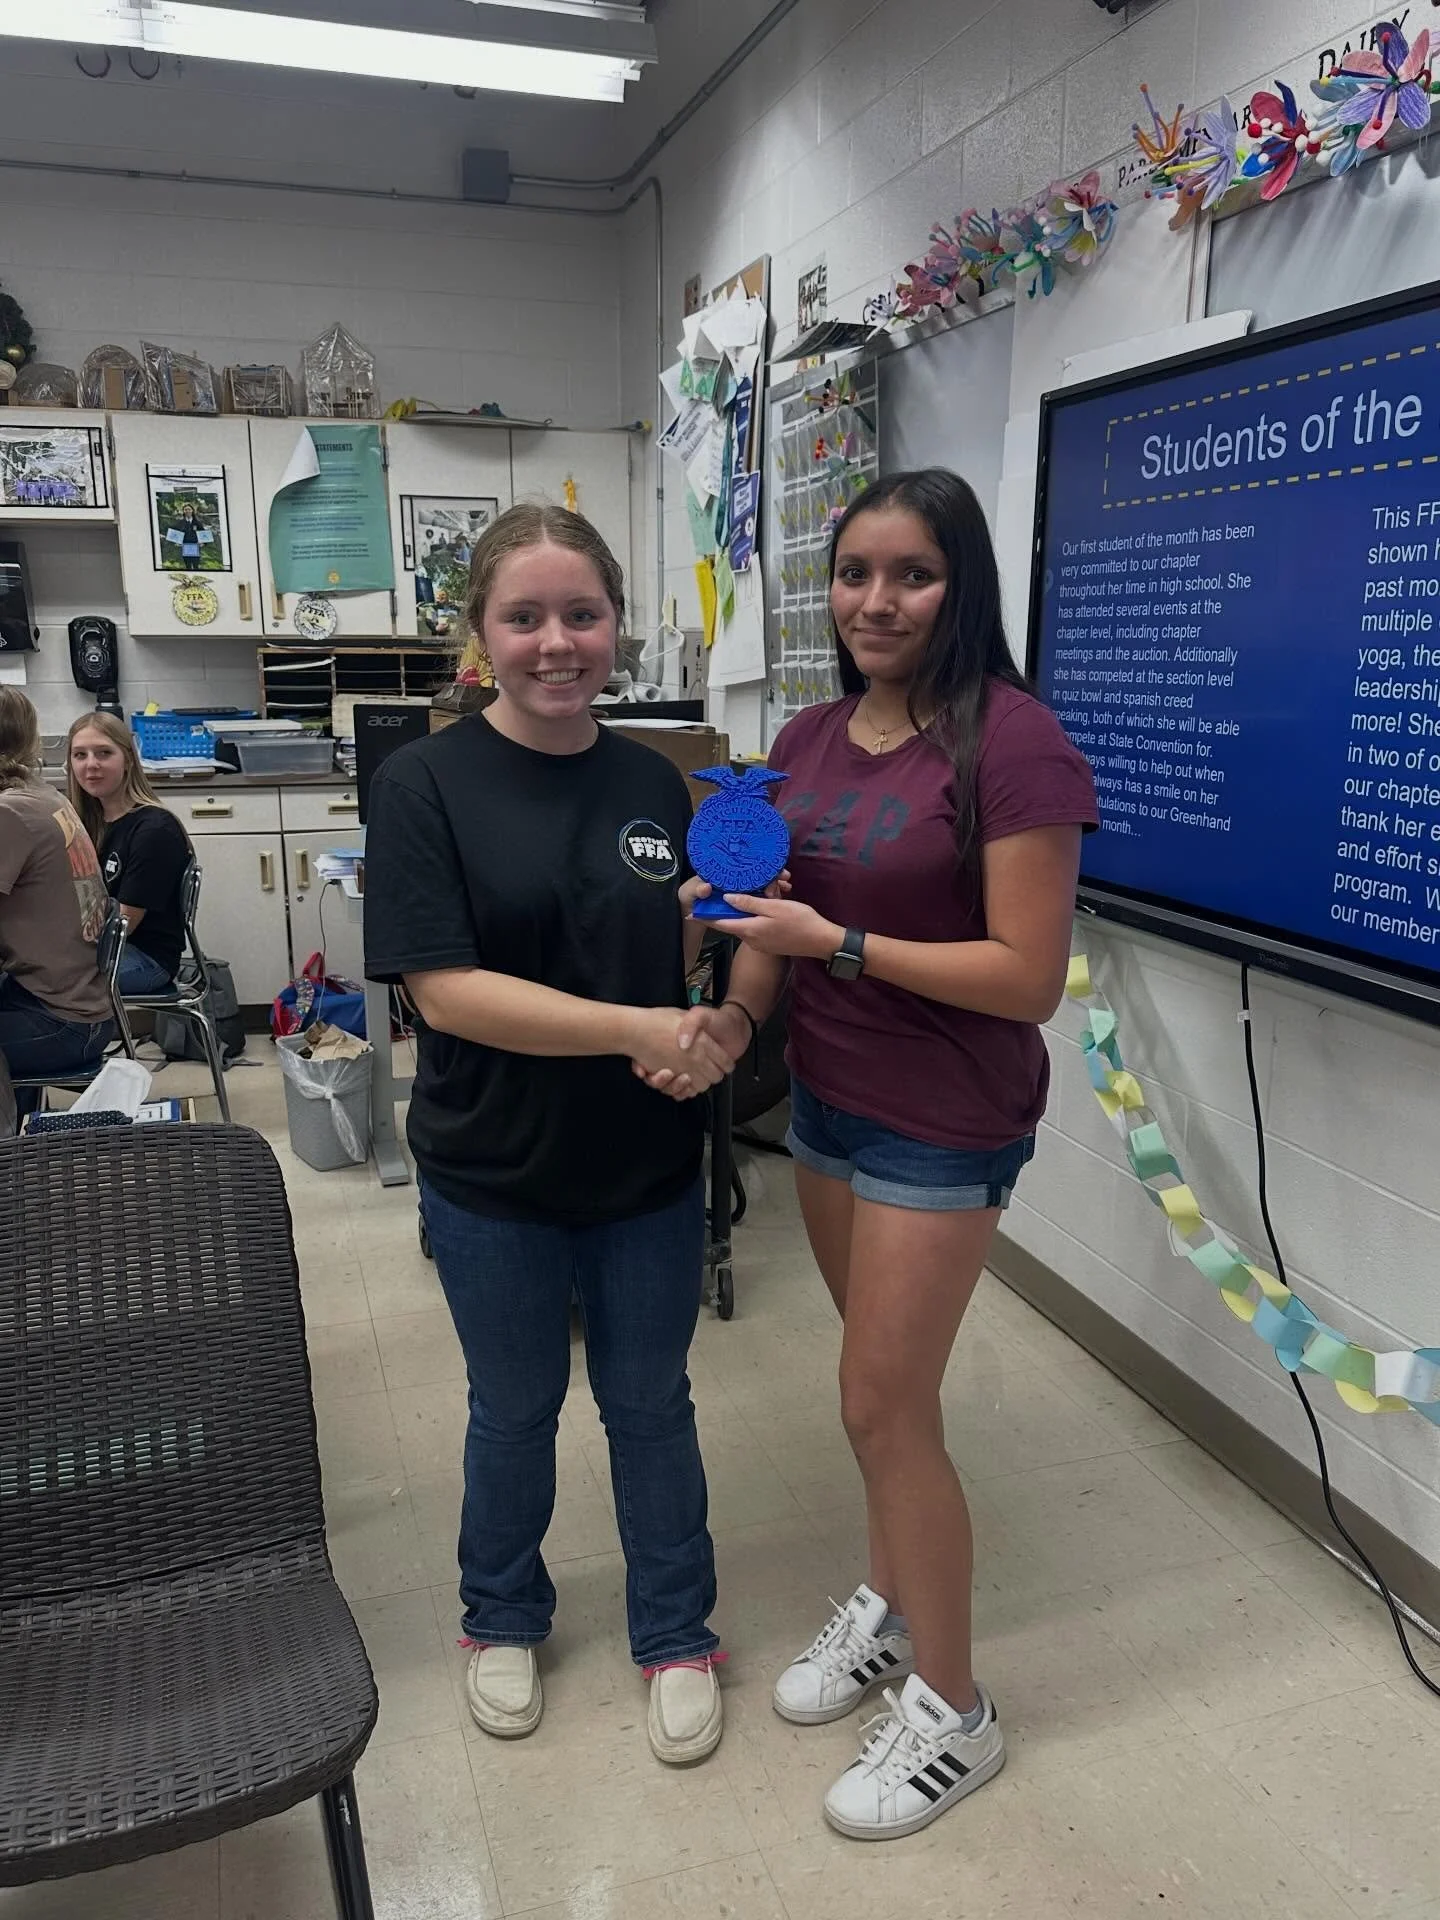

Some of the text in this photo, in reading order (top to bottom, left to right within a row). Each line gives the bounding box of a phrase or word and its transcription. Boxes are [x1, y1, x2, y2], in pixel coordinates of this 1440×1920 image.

[1141, 390, 1422, 479] Students of the
[1373, 506, 1410, 530] This
[1062, 523, 1255, 556] Our first student of the month has been
[1061, 553, 1200, 579] very committed to our chapter
[1368, 542, 1427, 564] shown
[1059, 572, 1251, 600] throughout her time in high school. She
[1364, 576, 1403, 604] past
[1058, 598, 1222, 618] has attended several events at the
[1056, 623, 1201, 643] chapter level, including chapter
[1362, 609, 1432, 637] multiple
[1055, 647, 1238, 666] meetings and the auction. Additionally
[1357, 648, 1406, 671] yoga,
[1054, 667, 1234, 687] she has competed at the section level
[1052, 687, 1193, 708] in quiz bowl and spanish creed
[1354, 676, 1440, 707] leadershi
[367, 715, 408, 727] acer
[1093, 710, 1112, 724] both
[1115, 710, 1125, 726] of
[1127, 712, 1154, 729] which
[1157, 716, 1176, 731] she
[1179, 717, 1195, 732] will
[1199, 717, 1212, 734] be
[1215, 719, 1240, 736] able
[1351, 712, 1401, 733] more!
[1098, 731, 1107, 745] at
[1109, 733, 1134, 749] State
[1136, 735, 1193, 755] Convention
[1197, 740, 1213, 758] for.
[1347, 741, 1362, 763] in
[1368, 744, 1399, 767] two
[1405, 748, 1425, 770] of
[1108, 754, 1136, 774] willing
[1139, 757, 1148, 772] to
[1150, 759, 1172, 778] help
[1175, 763, 1192, 778] out
[1195, 767, 1224, 783] when
[1125, 778, 1142, 793] has
[1144, 782, 1151, 794] a
[1154, 782, 1181, 800] smile
[1183, 787, 1197, 802] on
[1200, 788, 1219, 806] her
[1344, 777, 1373, 796] our
[720, 819, 758, 833] FFA
[1139, 801, 1148, 815] to
[1150, 807, 1168, 821] our
[1170, 807, 1231, 832] Greenhand
[1341, 806, 1389, 833] thank
[1394, 813, 1425, 838] her
[630, 842, 673, 860] FFA
[1337, 841, 1440, 876] and effort s
[709, 858, 768, 877] EDUCATION
[1333, 872, 1412, 905] program.
[1330, 904, 1359, 924] our
